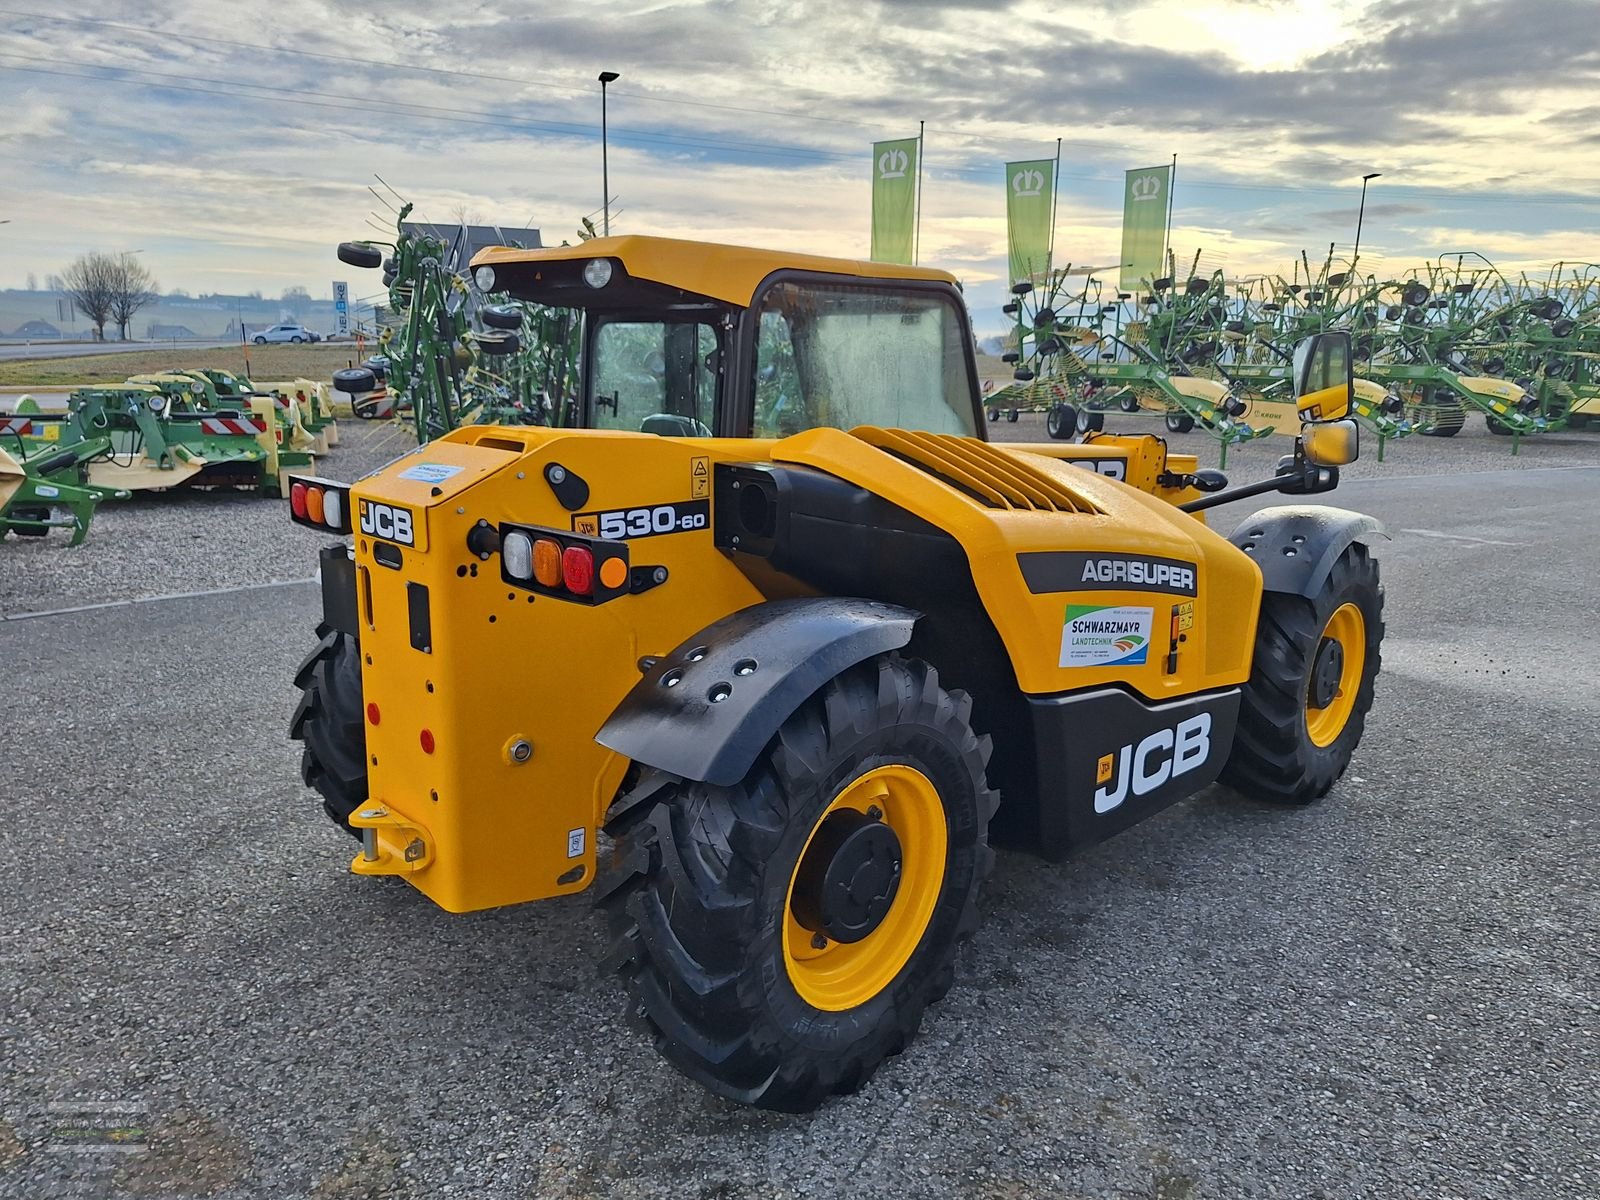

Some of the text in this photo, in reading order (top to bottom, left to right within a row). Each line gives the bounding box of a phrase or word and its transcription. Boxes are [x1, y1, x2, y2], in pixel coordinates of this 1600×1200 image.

[360, 502, 413, 544] JCB
[600, 506, 705, 539] 530-60
[1081, 559, 1194, 590] AGRISUPER
[1071, 620, 1140, 634] SCHWARZMAYR
[1071, 637, 1113, 646] LANDTECHNIK
[1094, 712, 1212, 814] JCB
